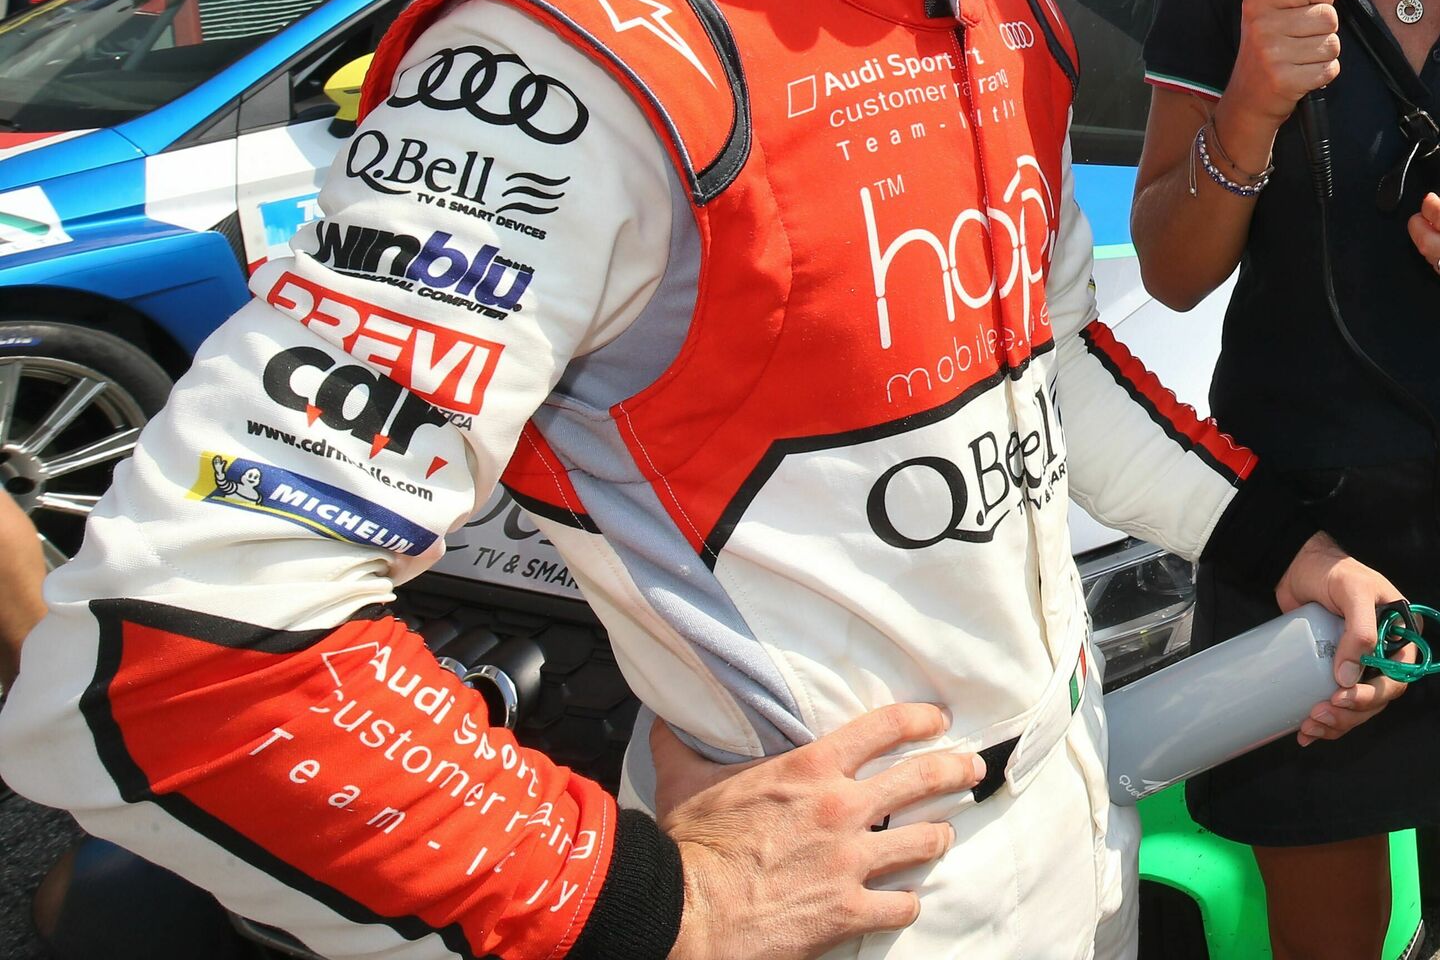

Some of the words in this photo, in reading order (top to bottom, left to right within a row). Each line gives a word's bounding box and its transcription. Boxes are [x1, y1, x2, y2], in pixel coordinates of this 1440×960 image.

[824, 58, 886, 97] Audi
[886, 51, 956, 83] Sport
[829, 82, 947, 129] customer
[837, 120, 927, 162] Team
[346, 130, 494, 206] Q.Bell
[874, 174, 906, 201] TM
[416, 192, 433, 205] TV
[436, 198, 447, 209] &
[449, 201, 495, 224] SMART
[496, 216, 547, 240] DEVICES
[418, 287, 508, 321] COMPUTER
[268, 483, 416, 555] MICHELIN
[473, 547, 505, 569] TV
[502, 555, 521, 574] &
[367, 644, 456, 720] Audi
[453, 712, 541, 798] Sport
[249, 726, 408, 835] Team
[309, 689, 507, 816] customer
[503, 801, 598, 861] raing
